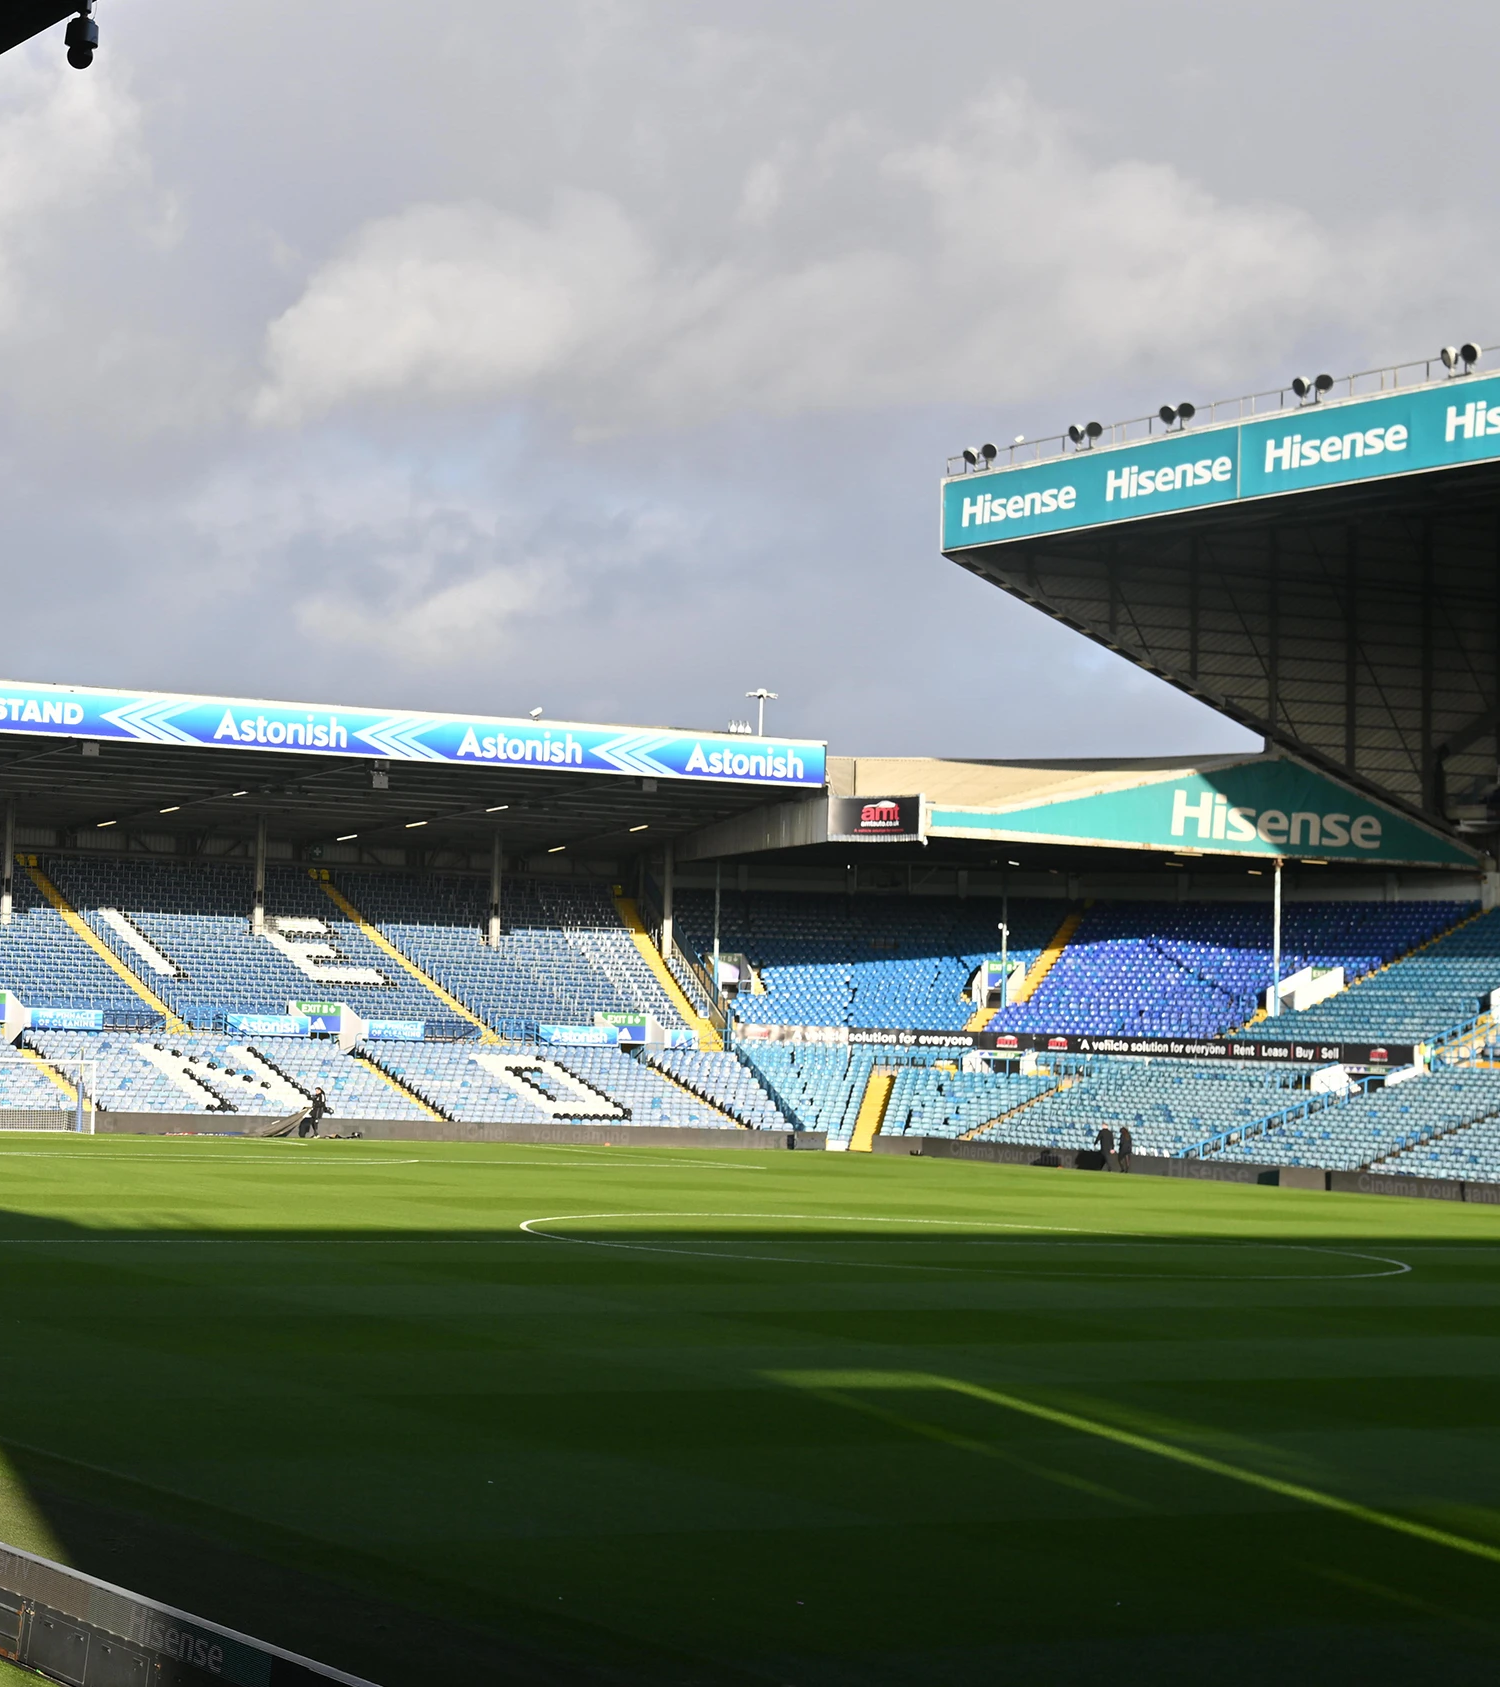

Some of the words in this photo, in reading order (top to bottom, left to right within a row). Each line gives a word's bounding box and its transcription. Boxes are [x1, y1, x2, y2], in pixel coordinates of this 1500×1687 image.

[1264, 424, 1408, 473] Hisense
[1106, 455, 1232, 502] Hisense
[961, 485, 1077, 527] Hisense
[213, 709, 347, 748] Astonish
[456, 727, 582, 764] Astonish
[685, 743, 804, 779] Astonish
[861, 803, 900, 821] amt
[1170, 789, 1382, 850] Hisense
[302, 1003, 322, 1013] EXIT
[607, 1015, 627, 1024] EXIT
[239, 1017, 300, 1034] Astonish
[551, 1026, 608, 1043] Astonish
[849, 1032, 896, 1043] solution
[899, 1033, 916, 1044] for
[918, 1035, 973, 1047] everyone
[1092, 1041, 1128, 1052] vehicle
[1130, 1042, 1168, 1053] solution
[1170, 1043, 1185, 1053] for
[1185, 1045, 1226, 1056] everyone
[1233, 1046, 1256, 1056] Rent
[1262, 1046, 1288, 1058] Lease
[1295, 1047, 1314, 1059] Buy
[1320, 1048, 1339, 1059] Sell
[950, 1142, 994, 1158] Cinema
[998, 1147, 1023, 1163] your
[1168, 1160, 1250, 1182] Hisense
[1357, 1174, 1417, 1196] Cinema
[1422, 1182, 1459, 1199] your
[129, 1604, 224, 1675] Hisense
